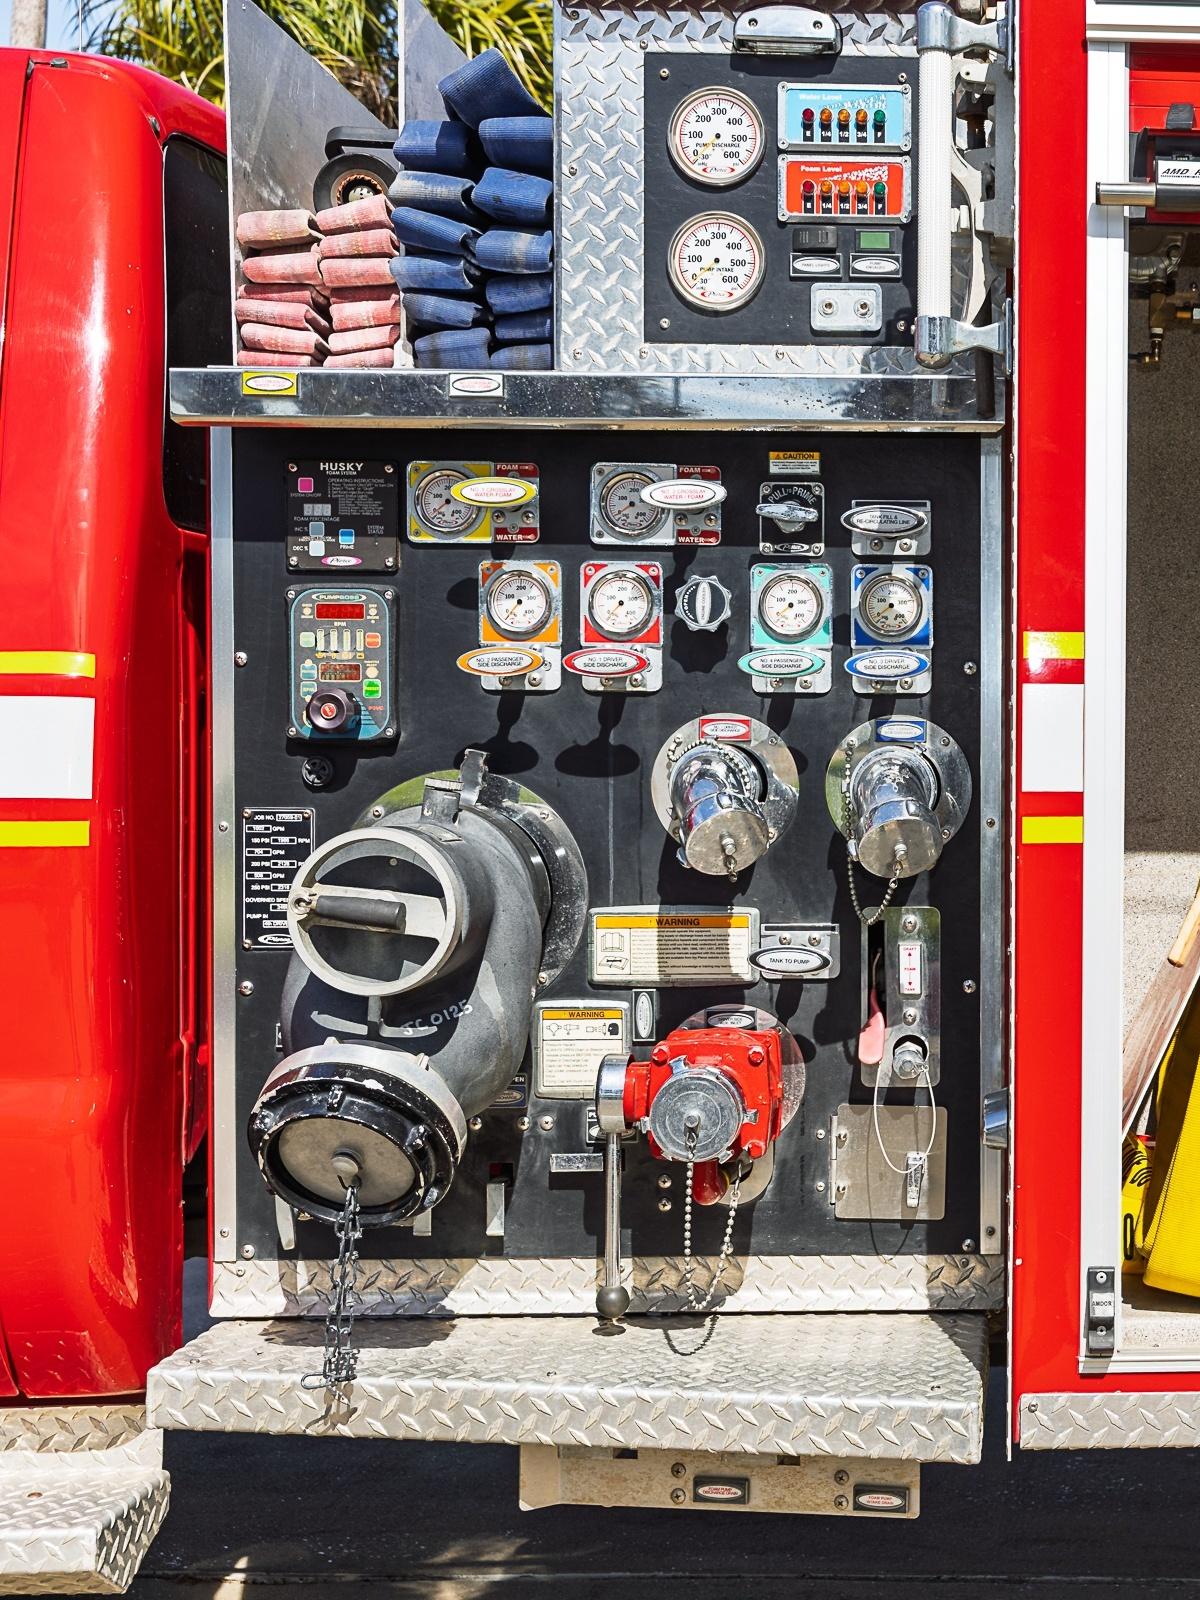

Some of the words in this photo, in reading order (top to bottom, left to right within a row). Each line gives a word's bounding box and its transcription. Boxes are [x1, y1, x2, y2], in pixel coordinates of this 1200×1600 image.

[695, 114, 711, 122] 200
[731, 134, 747, 142] 500
[723, 151, 740, 159] 600
[726, 242, 742, 250] 400
[730, 259, 746, 267] 500
[691, 273, 697, 281] 0
[722, 276, 738, 284] 600
[320, 462, 364, 471] HUSKY
[768, 488, 787, 504] PULL
[792, 486, 817, 504] PRIME
[656, 918, 700, 926] WARNING
[430, 1000, 473, 1025] 0125
